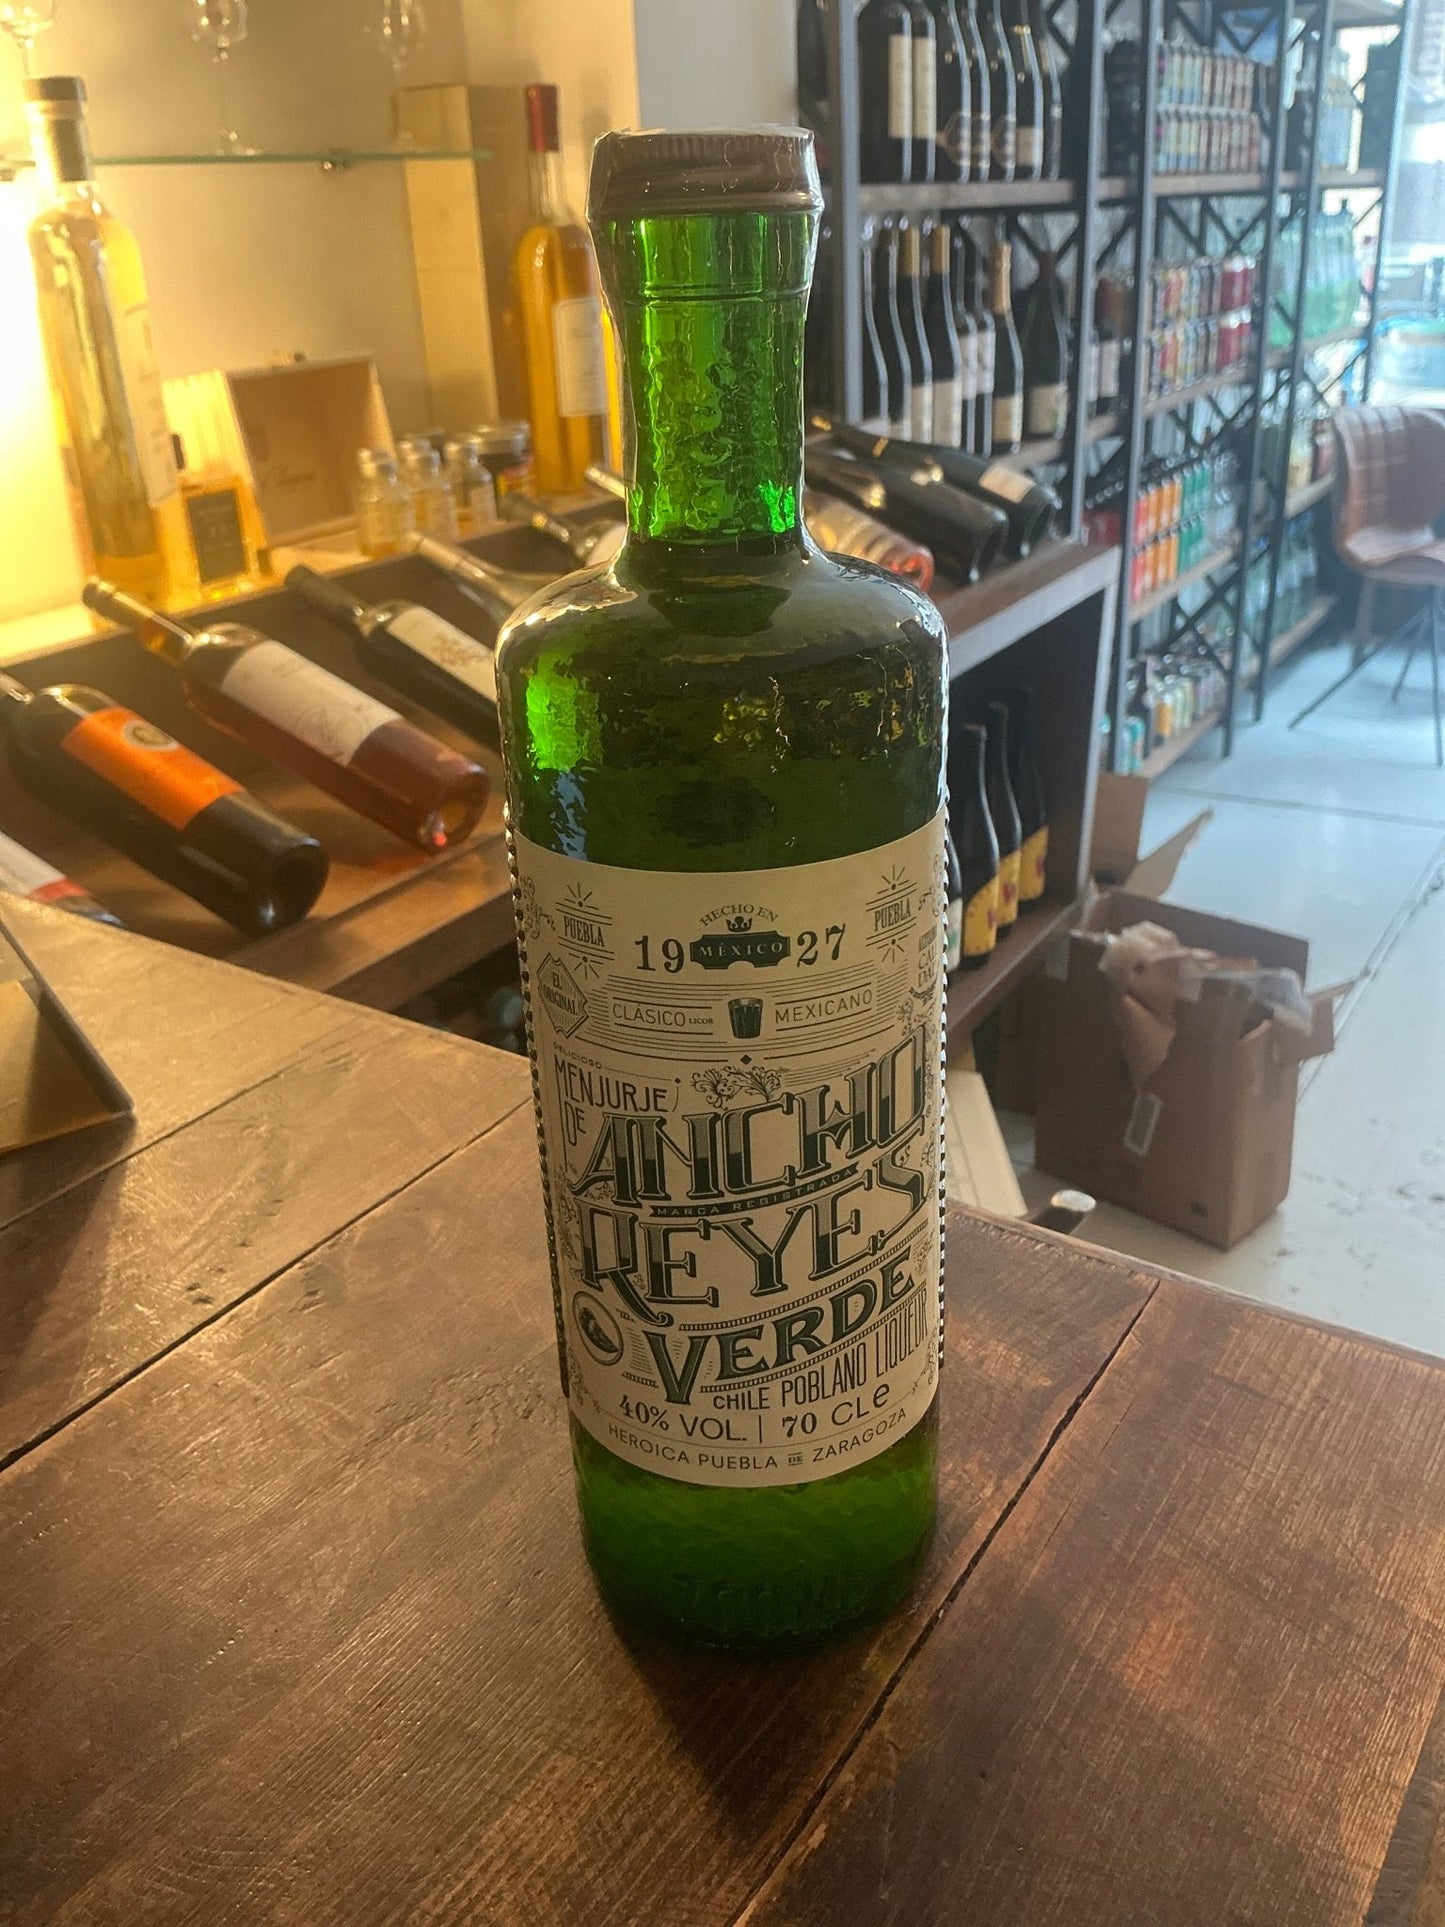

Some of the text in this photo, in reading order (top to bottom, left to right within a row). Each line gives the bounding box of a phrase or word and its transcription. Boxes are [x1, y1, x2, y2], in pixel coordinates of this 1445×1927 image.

[564, 915, 605, 947] PUEBLA
[700, 904, 778, 926] HECHO EN
[875, 897, 911, 931] PUEBLA
[635, 923, 845, 973] 19 MÉXICO 27
[612, 989, 873, 1027] CLÁSICO LICOR MEXICANO
[553, 1041, 603, 1069] DELICIOSO
[554, 1054, 669, 1112] MENJURJE
[565, 1100, 586, 1146] DE
[570, 1023, 926, 1206] ANCHO
[657, 1168, 853, 1217] MARCA REGISTRADA
[574, 1115, 929, 1328] REYES
[642, 1246, 915, 1405] VERDE
[713, 1288, 928, 1411] CHILE POBLANO LIQUEUR
[608, 1408, 907, 1470] HEROICA PUEBLA DE ZARAGOZA
[619, 1395, 670, 1431] 40%
[679, 1413, 748, 1442] VOL.
[782, 1412, 817, 1438] 70
